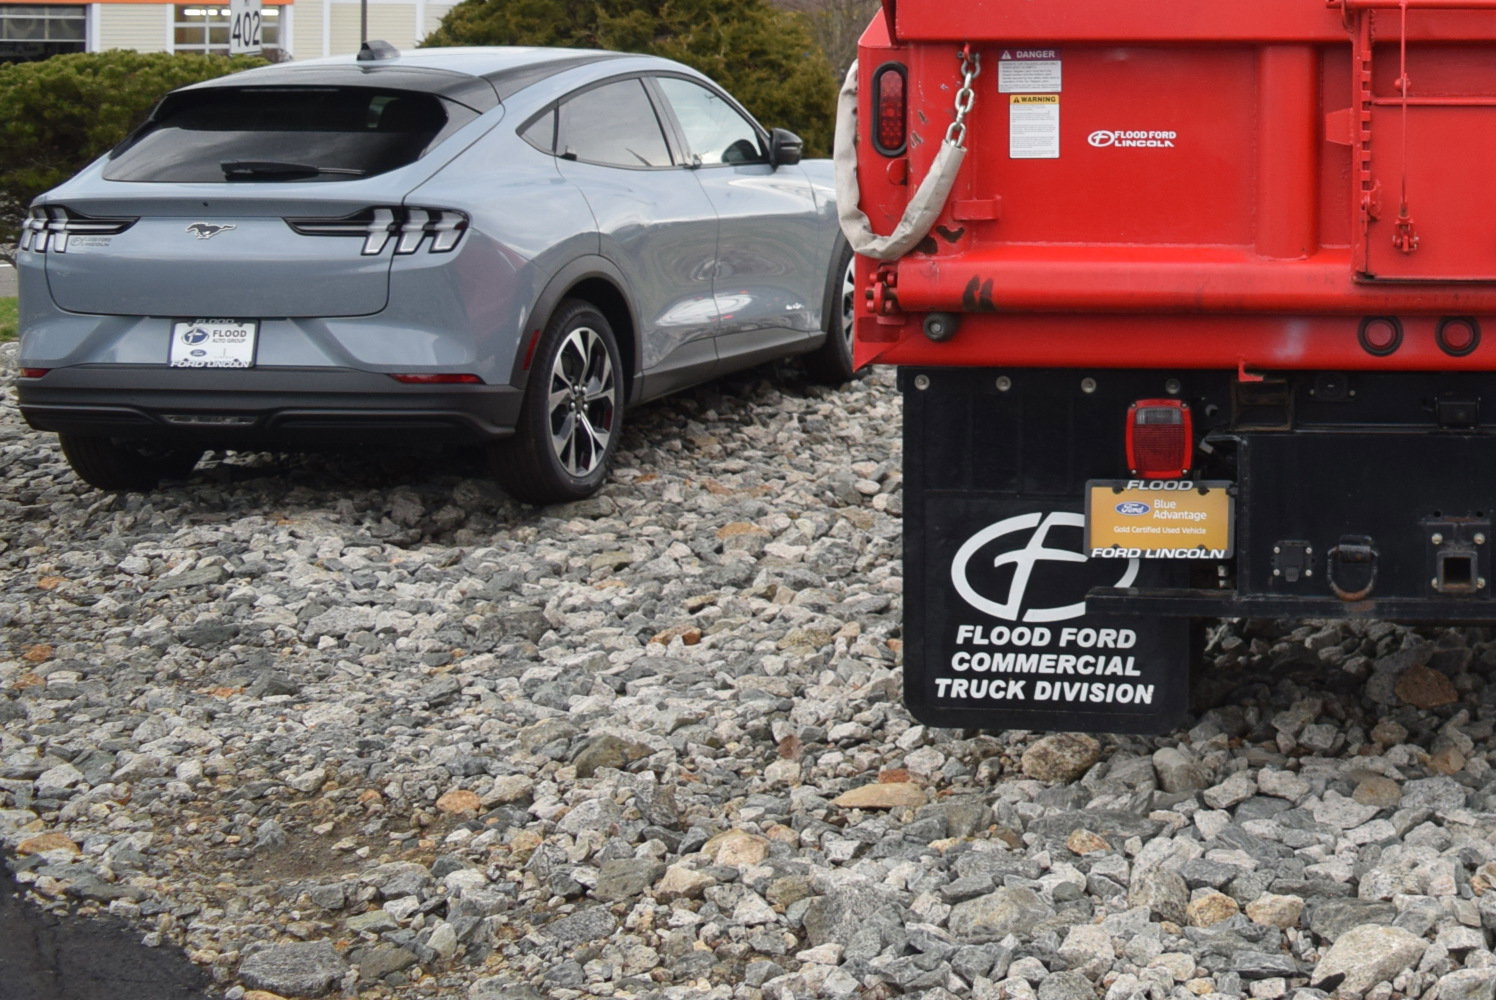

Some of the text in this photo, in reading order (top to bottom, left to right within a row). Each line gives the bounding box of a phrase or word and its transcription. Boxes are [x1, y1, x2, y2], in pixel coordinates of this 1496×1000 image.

[232, 10, 260, 48] 402
[1016, 50, 1056, 59] DANGER
[1114, 130, 1177, 139] FLOOD FORD
[212, 329, 247, 338] FLOOD
[170, 360, 251, 368] FORD LINCOLN
[1127, 480, 1194, 491] FLOOD
[1153, 499, 1177, 509] Blue
[1153, 510, 1208, 522] Advantage
[1113, 525, 1206, 534] Gold Certified Used Vehicle
[1091, 547, 1226, 559] FORD LINCOLN
[956, 624, 1137, 649] FLOOD FORD
[951, 650, 1142, 677] COMMERCIAL
[934, 677, 1155, 705] TRUCK DIVISION
